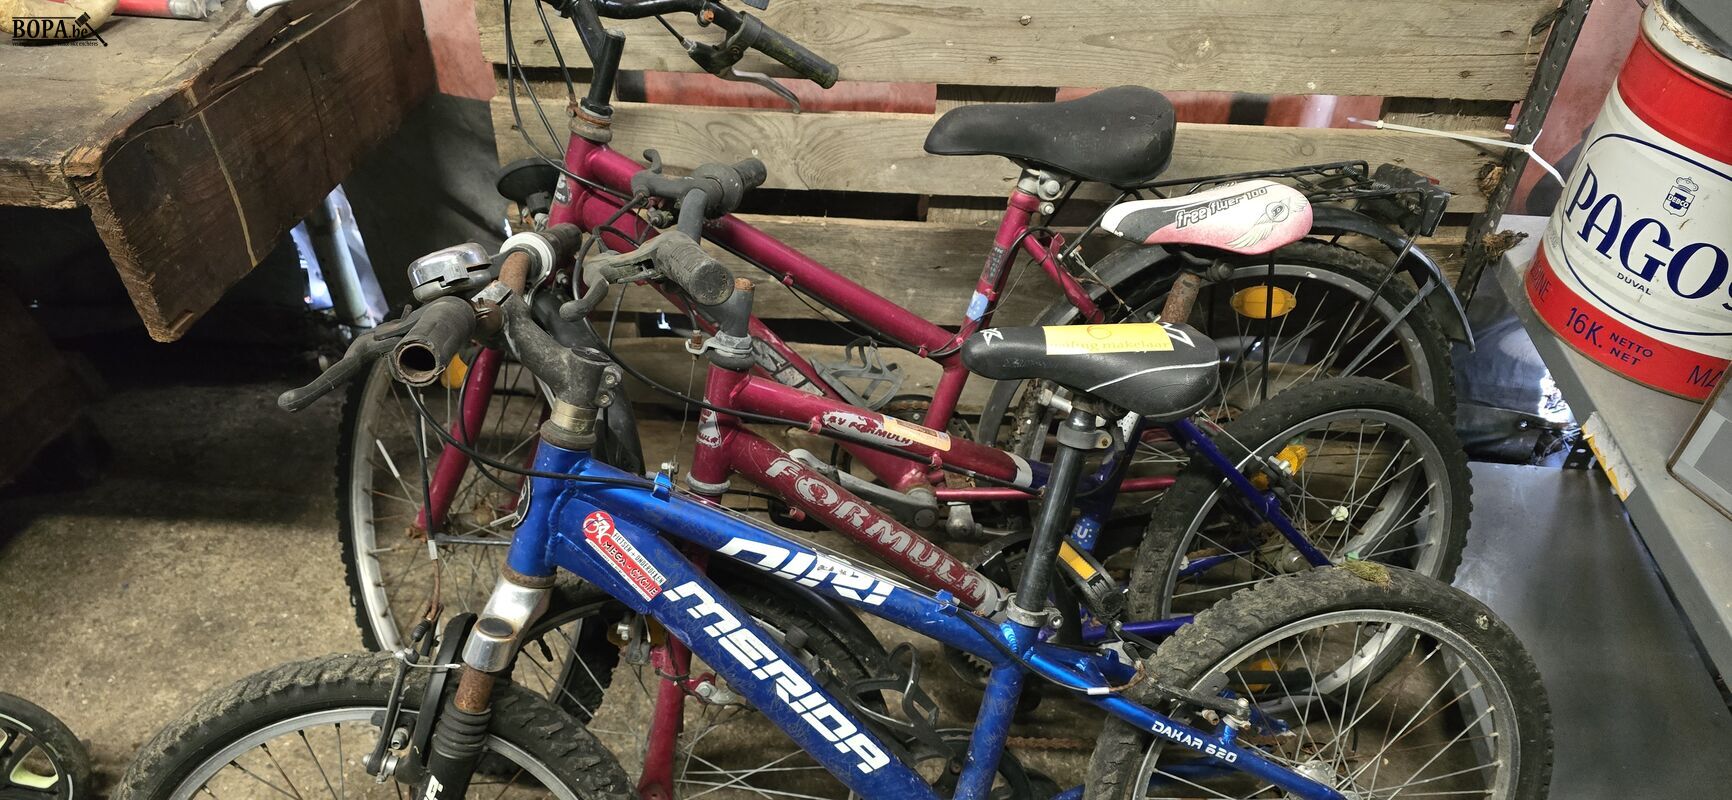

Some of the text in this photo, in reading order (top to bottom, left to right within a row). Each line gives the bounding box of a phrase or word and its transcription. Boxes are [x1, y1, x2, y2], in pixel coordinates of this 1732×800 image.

[1175, 186, 1269, 230] free flyer 100
[1667, 194, 1690, 209] DEBCO
[1616, 271, 1653, 297] DUVAL
[1609, 331, 1654, 358] NETTO
[1609, 347, 1641, 366] NET
[765, 457, 988, 600] FORMULA
[663, 580, 891, 774] MERIDA
[1151, 720, 1238, 763] DAKAR 620
